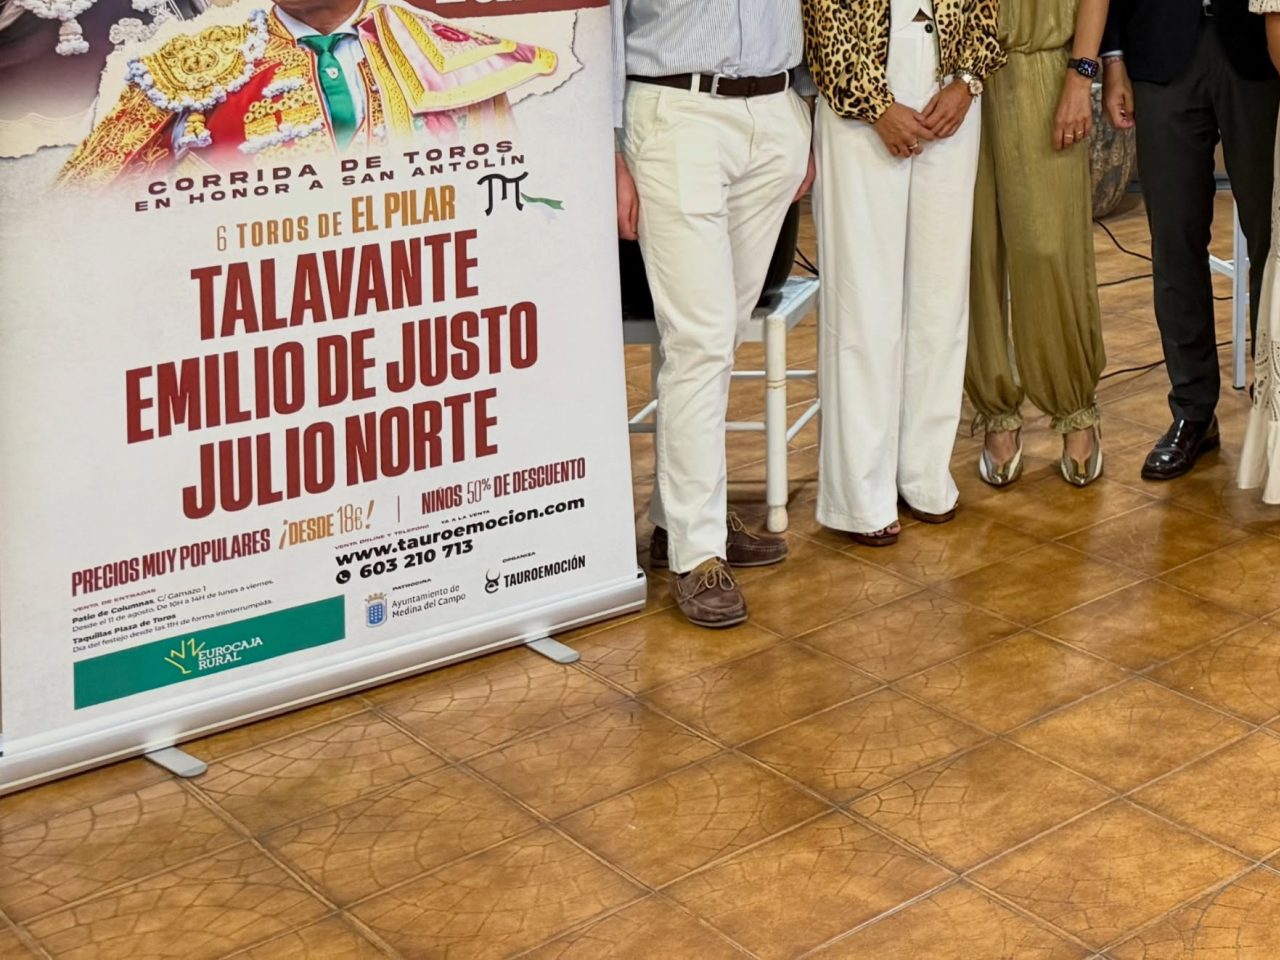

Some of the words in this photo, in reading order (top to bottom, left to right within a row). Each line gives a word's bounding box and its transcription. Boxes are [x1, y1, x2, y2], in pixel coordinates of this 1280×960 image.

[134, 197, 170, 212] EN
[188, 183, 290, 204] HONOR
[308, 178, 324, 190] A
[341, 170, 395, 186] SAN
[411, 153, 526, 178] ANTOLÍN
[148, 162, 318, 196] CORRIDA
[341, 155, 382, 172] DE
[403, 140, 513, 164] TOROS
[216, 225, 228, 251] 6
[236, 215, 309, 249] TOROS
[318, 211, 342, 238] DE
[351, 194, 378, 234] EL
[384, 184, 456, 229] PILAR
[190, 229, 479, 341] TALAVANTE
[126, 340, 305, 445] EMILIO
[317, 328, 377, 409] DE
[386, 300, 538, 395] JUSTO
[181, 420, 336, 521] JULIO
[345, 387, 499, 487] NORTE
[422, 483, 463, 515] NIÑOS
[467, 477, 491, 505] 50%
[494, 475, 511, 499] DE
[512, 457, 586, 494] DESCUENTO
[335, 497, 585, 567] www.tauroemocion.com
[360, 558, 398, 580] 603
[404, 548, 436, 570] 210
[442, 540, 474, 559] 713
[71, 556, 140, 597] PRECIOS
[142, 547, 178, 580] MUY
[179, 528, 271, 571] POPULARES
[504, 554, 586, 588] TAUROEMOCIÓN
[72, 614, 96, 624] Patio
[392, 587, 449, 609] Ayuntamiento
[450, 584, 460, 595] de
[392, 603, 423, 618] Medina
[424, 599, 437, 612] del
[437, 593, 466, 610] Campo
[72, 630, 112, 645] Taquillas
[114, 623, 138, 634] Plaza
[198, 636, 264, 661] EUROCAJA
[198, 651, 242, 671] RURAL
